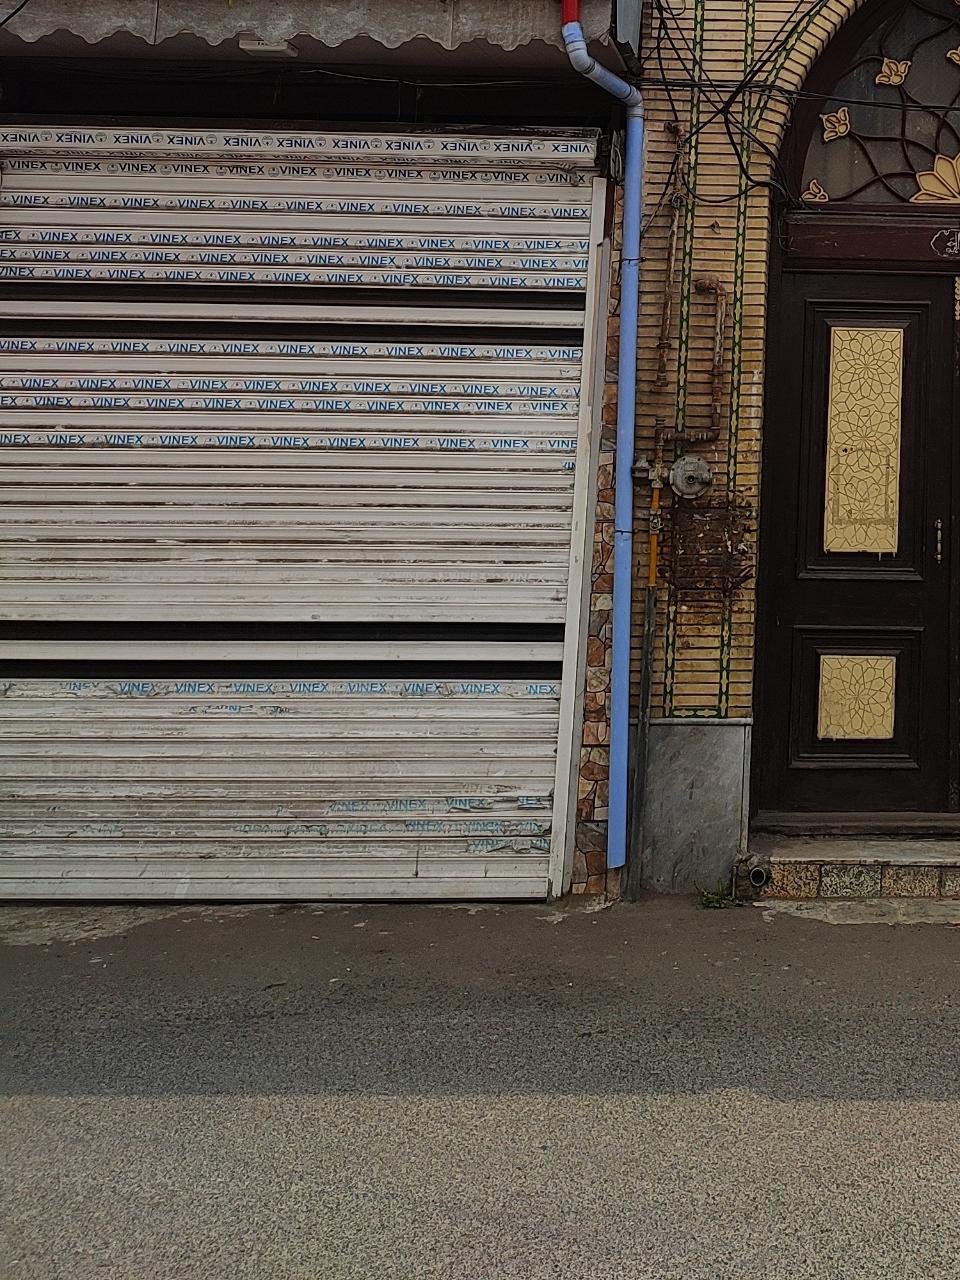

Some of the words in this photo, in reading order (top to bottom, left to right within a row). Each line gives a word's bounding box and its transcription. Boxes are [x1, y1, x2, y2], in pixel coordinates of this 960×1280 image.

[9, 161, 47, 170] VINEX
[63, 162, 101, 171] VINEX
[118, 163, 156, 172] VINEX
[172, 165, 209, 174] VINEX
[227, 166, 265, 175] VINEX
[280, 167, 317, 176] VINEX
[334, 168, 371, 177] VINEX
[386, 169, 423, 178] VINEX
[441, 170, 477, 179] VINEX
[492, 171, 529, 180] VINEX
[12, 196, 49, 205] VINEX
[68, 197, 106, 206] VINEX
[122, 198, 159, 207] VINEX
[177, 200, 215, 209] VINEX
[230, 201, 268, 210] VINEX
[286, 202, 322, 211] VINEX
[338, 203, 375, 212] VINEX
[393, 204, 429, 213] VINEX
[445, 206, 481, 215] VINEX
[499, 207, 536, 216] VINEX
[551, 208, 588, 217] VINEX
[40, 232, 77, 241] VINEX
[94, 233, 132, 242] VINEX
[150, 234, 188, 243] VINEX
[204, 235, 241, 244] VINEX
[260, 236, 296, 245] VINEX
[312, 237, 349, 246] VINEX
[367, 238, 403, 247] VINEX
[419, 239, 455, 248] VINEX
[473, 240, 510, 249] VINEX
[525, 241, 561, 250] VINEX
[54, 269, 91, 278] VINEX
[108, 270, 146, 279] VINEX
[164, 271, 202, 280] VINEX
[218, 273, 255, 282] VINEX
[274, 274, 310, 283] VINEX
[327, 275, 363, 284] VINEX
[382, 276, 419, 285] VINEX
[434, 277, 471, 286] VINEX
[490, 278, 527, 287] VINEX
[544, 279, 582, 288] VINEX
[20, 379, 59, 388] VINEX
[78, 380, 116, 389] VINEX
[133, 380, 171, 389] VINEX
[190, 381, 228, 390] VINEX
[244, 382, 281, 391] VINEX
[300, 383, 337, 392] VINEX
[353, 384, 391, 393] VINEX
[409, 385, 446, 394] VINEX
[462, 386, 499, 395] VINEX
[518, 387, 556, 396] VINEX
[118, 683, 157, 693] VINEX
[175, 683, 213, 693] VINEX
[234, 683, 273, 693] VINEX
[290, 683, 328, 693] VINEX
[346, 684, 387, 694] VINEX
[403, 684, 440, 694] VINEX
[460, 684, 501, 694] VINEX
